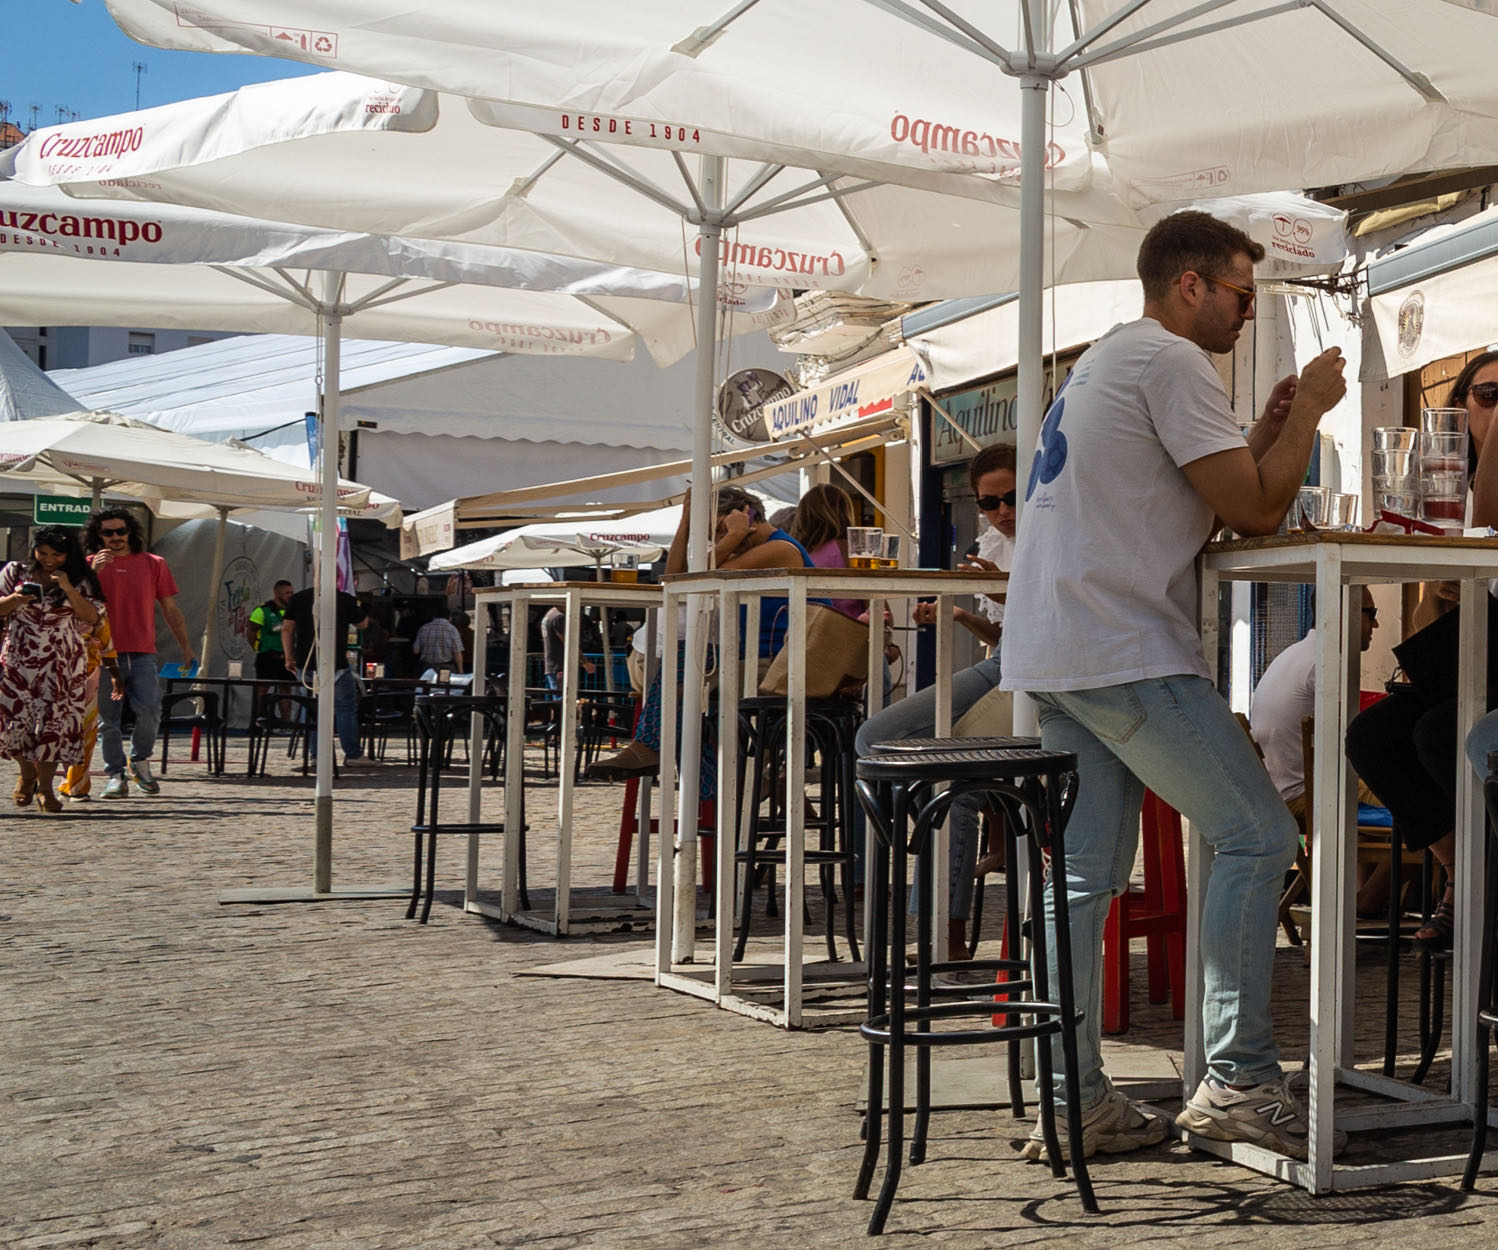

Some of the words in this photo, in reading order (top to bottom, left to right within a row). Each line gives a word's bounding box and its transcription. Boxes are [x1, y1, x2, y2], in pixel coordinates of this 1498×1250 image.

[562, 115, 632, 135] DESDE
[650, 124, 700, 143] 1904
[40, 126, 143, 159] Cruzcampo
[73, 244, 120, 257] 1904
[1272, 240, 1315, 258] reciclado
[772, 394, 818, 433] AQUILINO
[829, 379, 860, 413] VIDAL
[40, 502, 90, 513] ENTRAD
[590, 532, 650, 544] Cruzcampo
